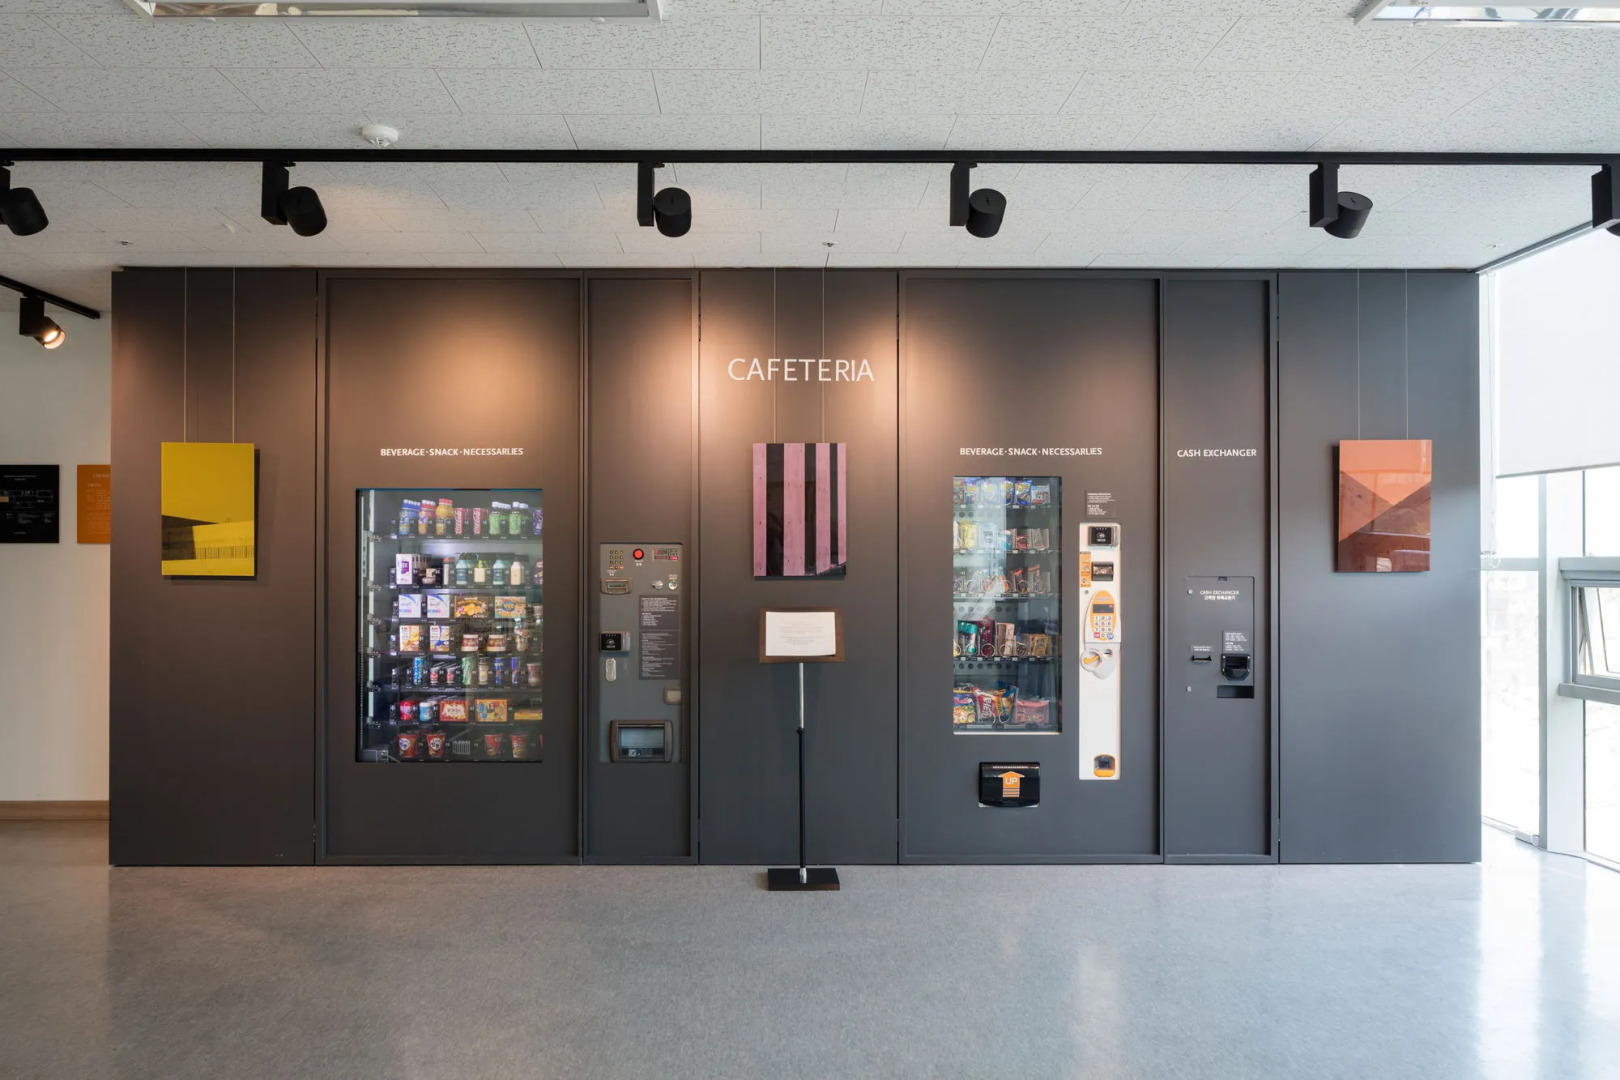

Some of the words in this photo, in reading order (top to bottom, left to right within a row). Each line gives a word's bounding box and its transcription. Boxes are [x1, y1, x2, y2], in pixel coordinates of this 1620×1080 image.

[728, 358, 875, 382] CAFETERIA
[1176, 449, 1200, 457] CASH
[1203, 449, 1257, 457] EXCHANGER
[1006, 777, 1018, 785] UP
